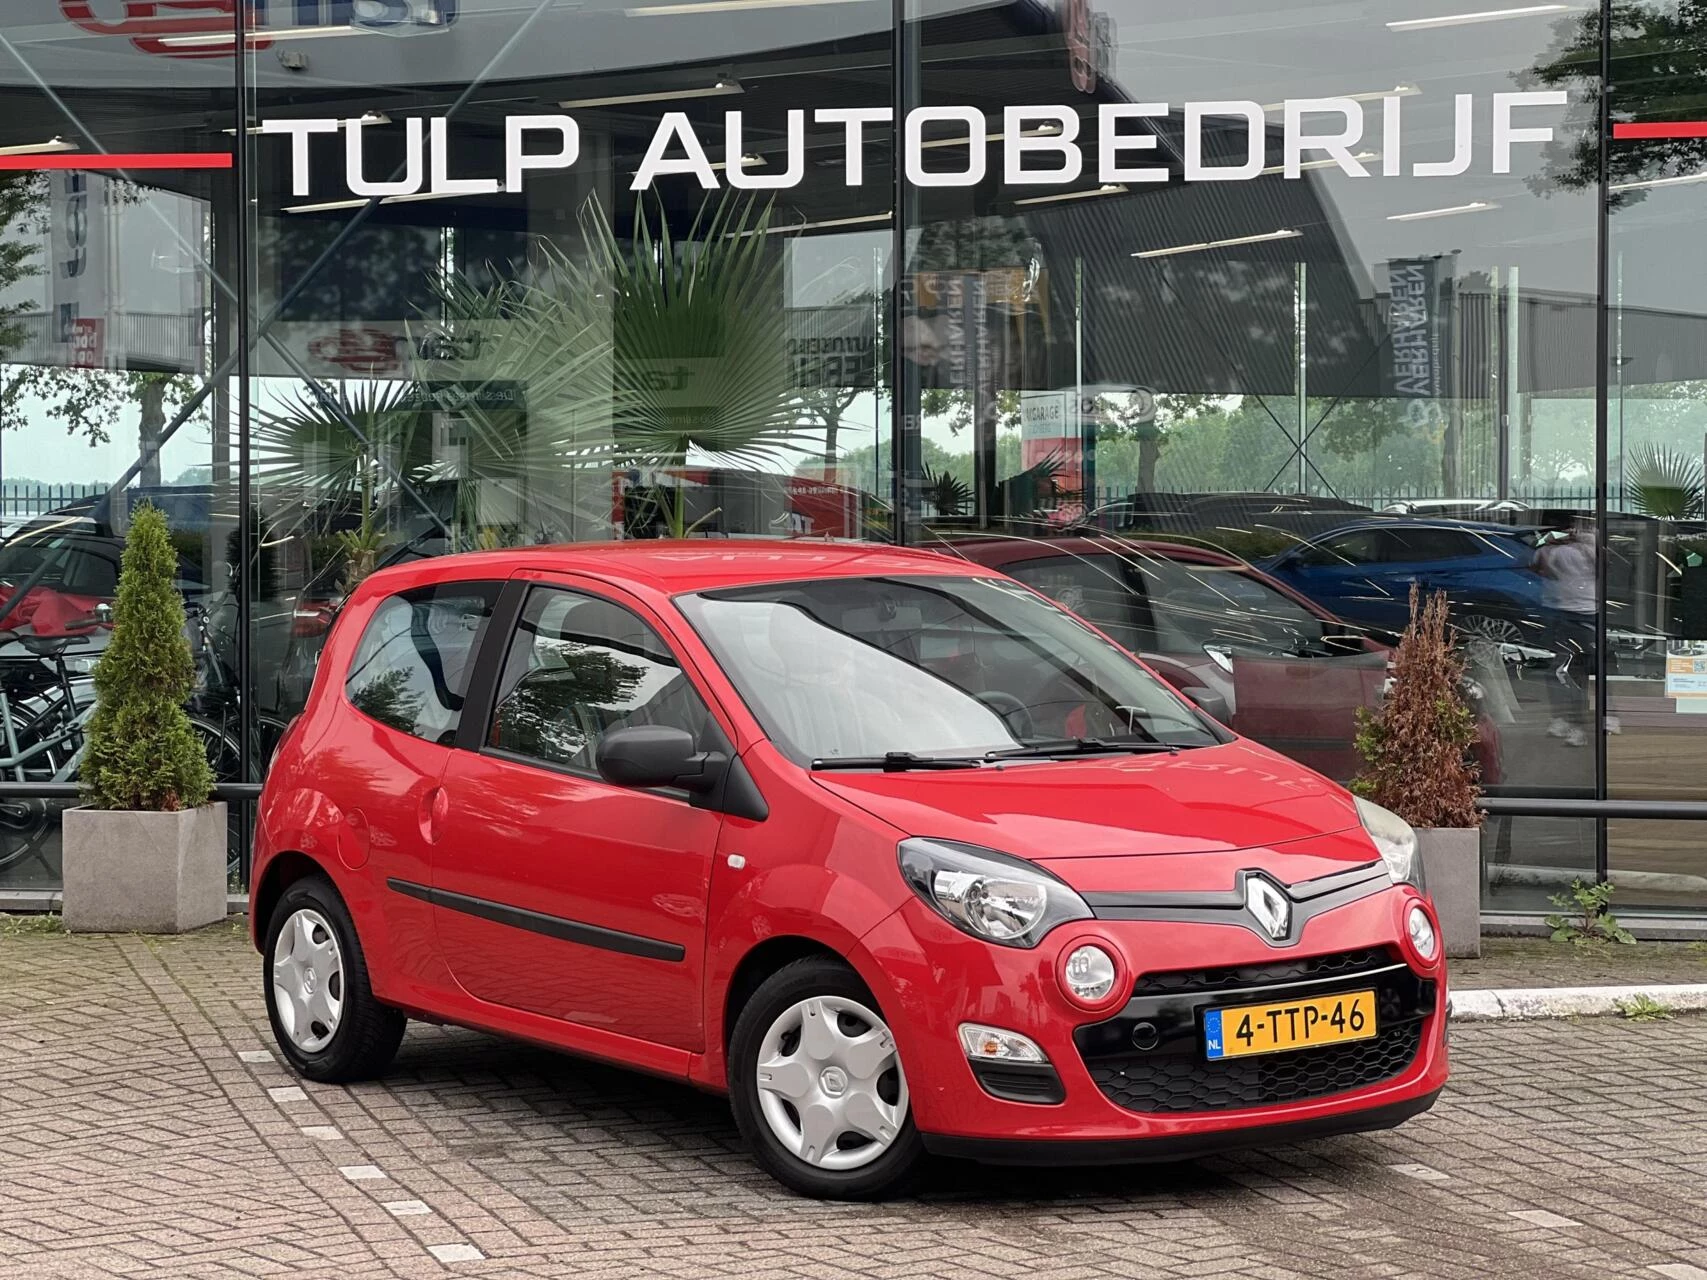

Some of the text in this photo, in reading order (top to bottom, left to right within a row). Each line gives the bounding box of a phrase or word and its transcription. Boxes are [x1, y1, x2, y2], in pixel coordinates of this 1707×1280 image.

[262, 91, 1568, 196] TULP AUTOBEDRIJF
[1208, 1039, 1222, 1051] NL
[1236, 999, 1365, 1047] 4-TTP-46
